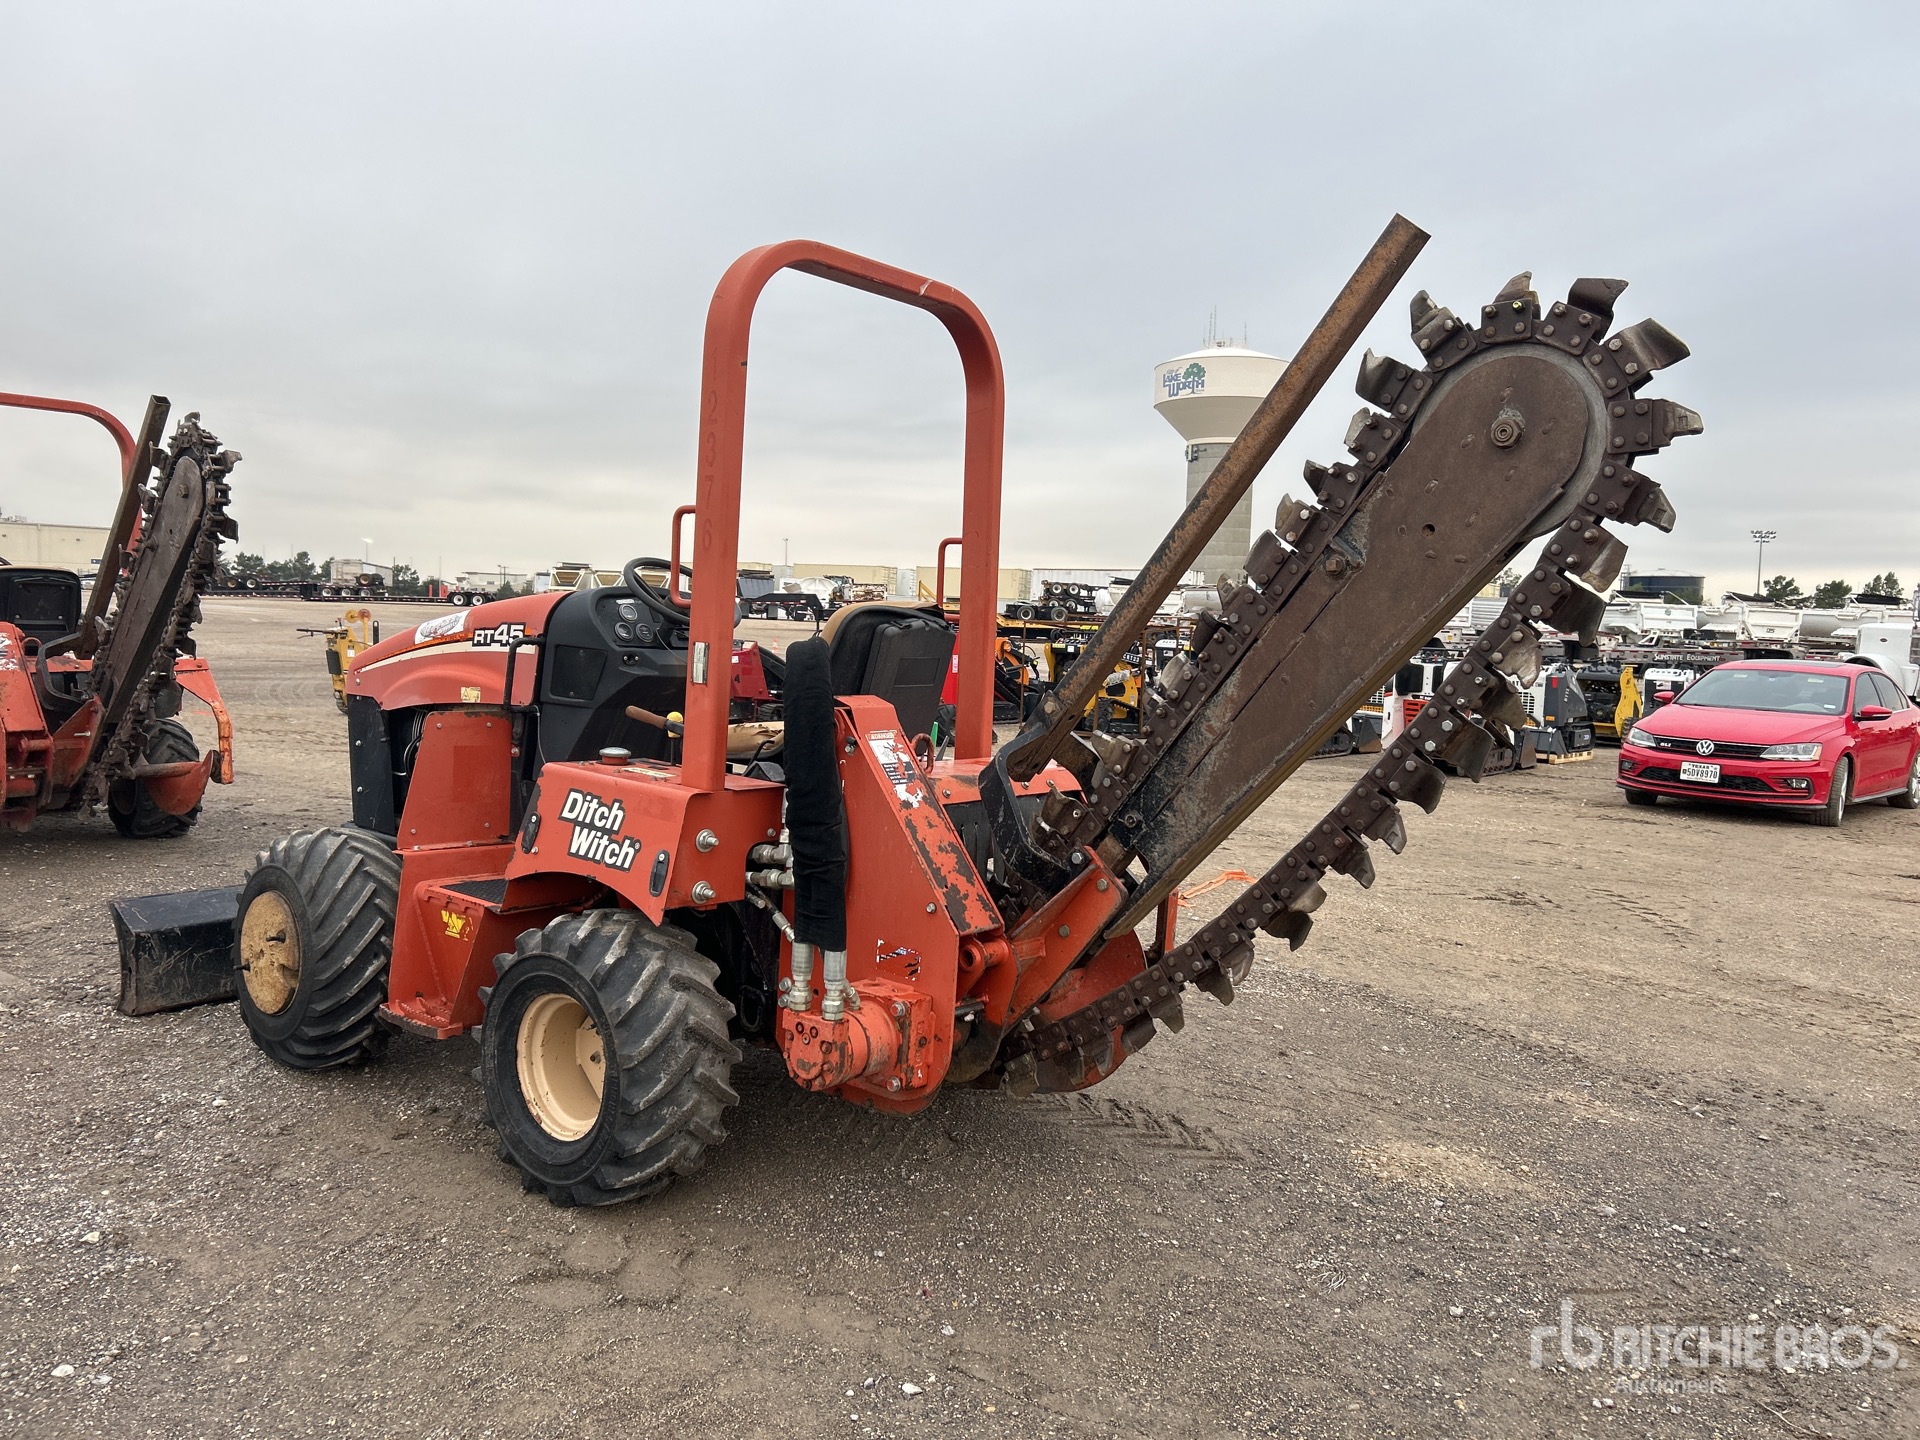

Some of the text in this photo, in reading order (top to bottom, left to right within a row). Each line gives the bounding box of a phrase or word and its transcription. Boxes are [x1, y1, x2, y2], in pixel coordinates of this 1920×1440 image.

[1163, 374, 1182, 388] LAKE
[1168, 380, 1205, 398] WORTH
[473, 623, 524, 645] RT45
[1653, 653, 1721, 662] SUNSTATE EQUIPMENT
[561, 791, 624, 831] Ditch
